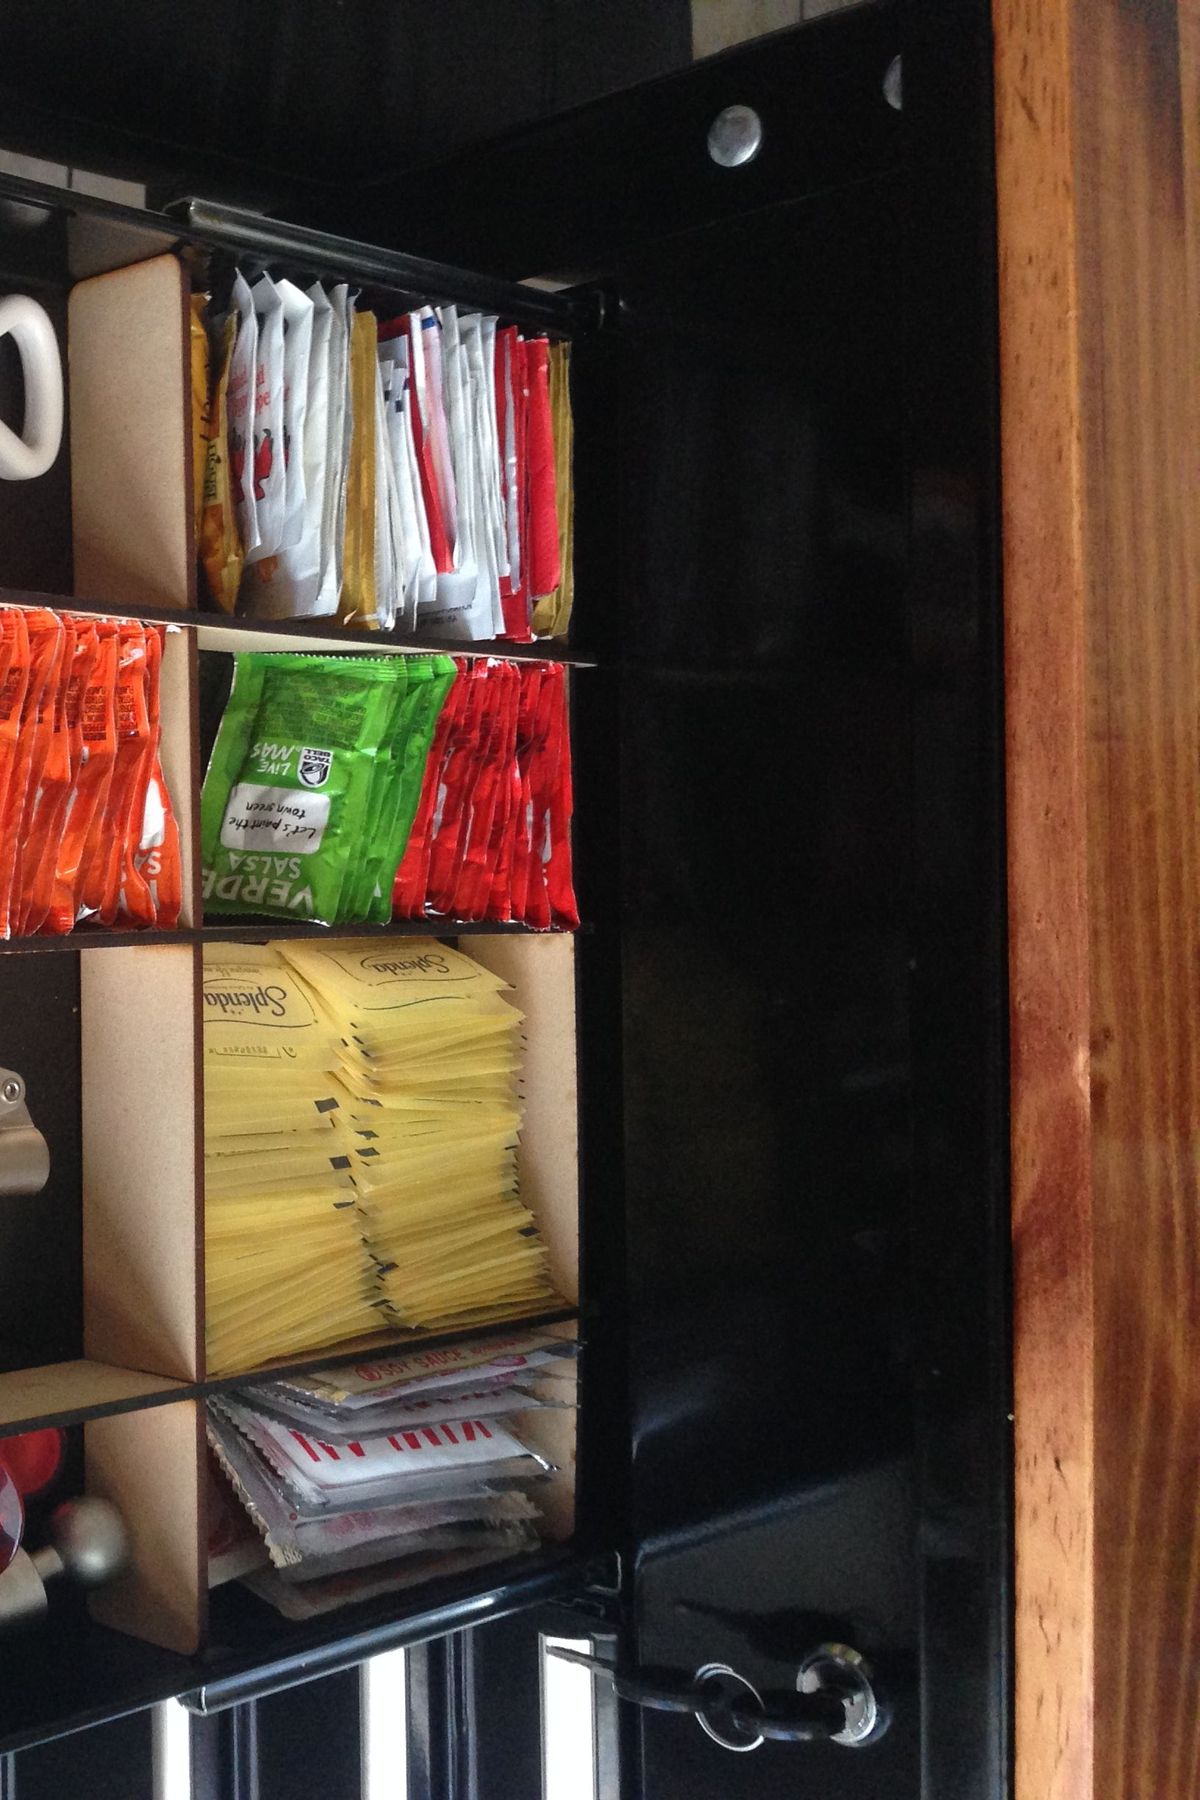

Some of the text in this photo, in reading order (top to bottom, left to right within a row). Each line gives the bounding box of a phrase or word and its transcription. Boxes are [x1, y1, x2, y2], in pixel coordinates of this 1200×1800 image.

[303, 754, 331, 763] TACO
[304, 748, 331, 756] BELL
[245, 801, 306, 819] town green
[228, 816, 317, 839] Let's paint the
[229, 852, 301, 878] SALSA
[372, 954, 450, 976] Splenda
[203, 986, 287, 1016] Splenda
